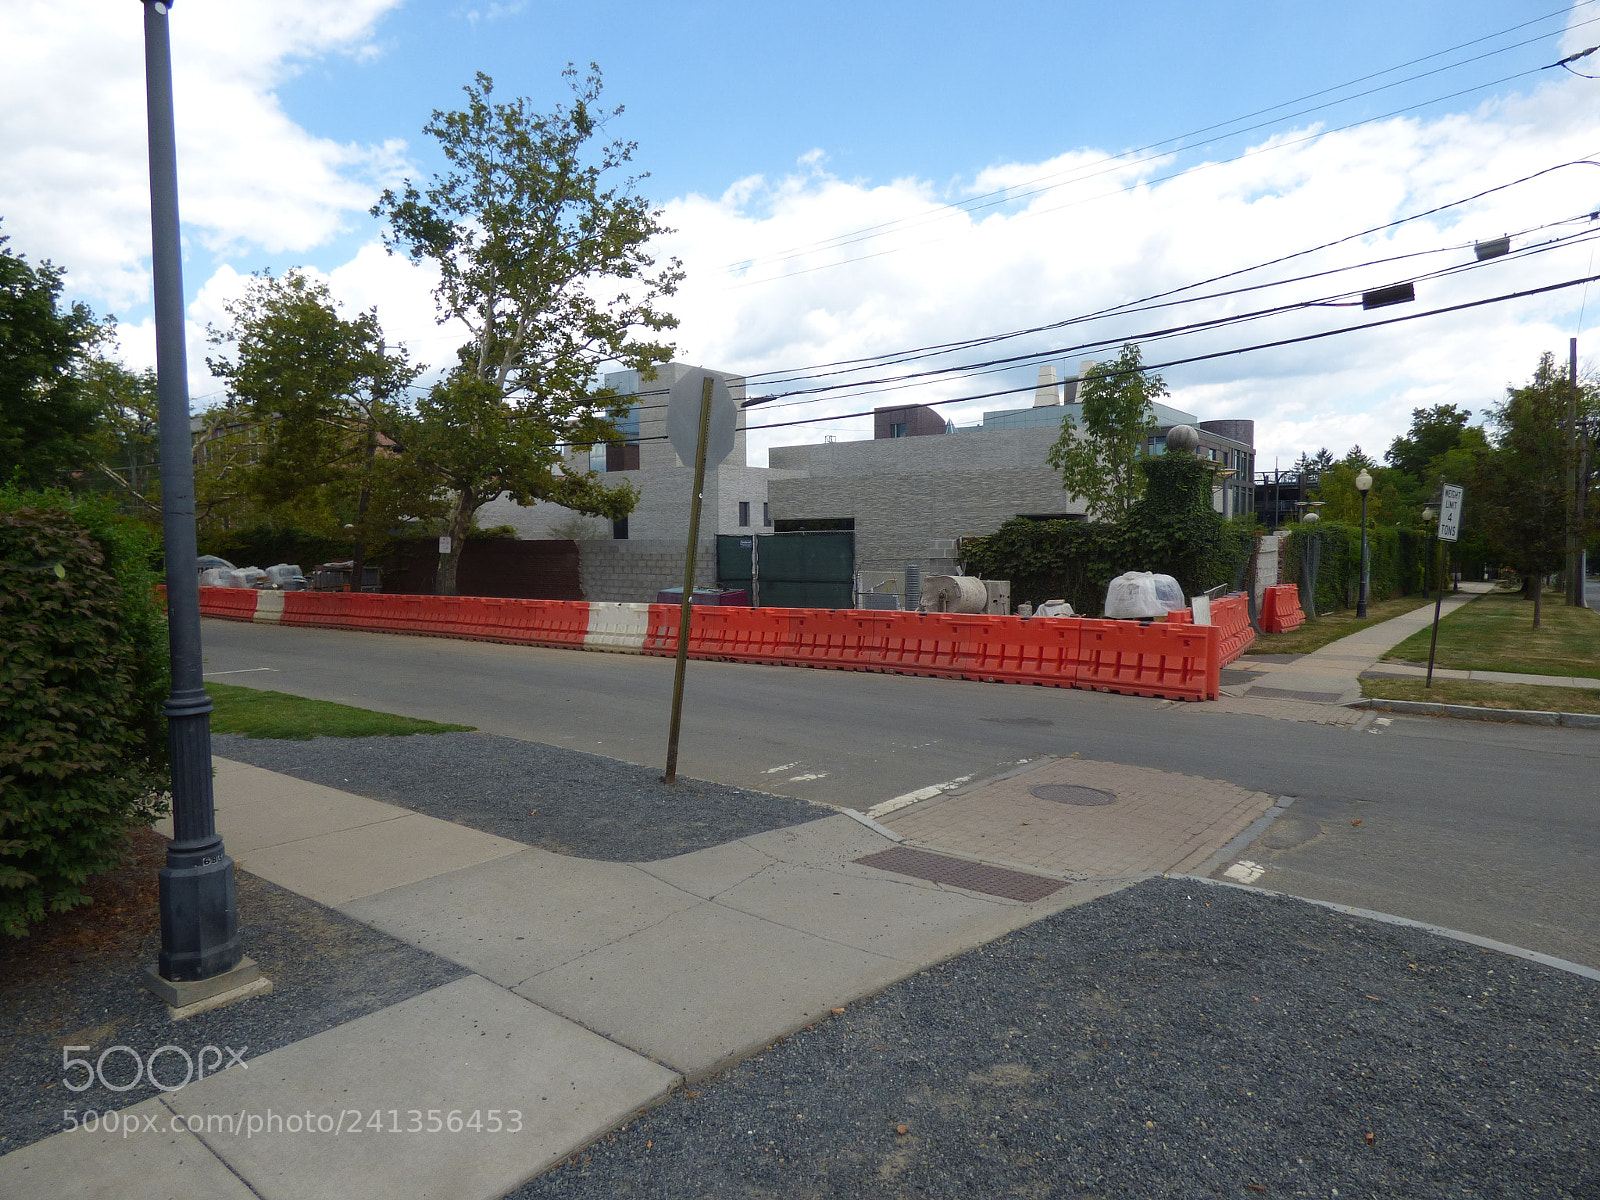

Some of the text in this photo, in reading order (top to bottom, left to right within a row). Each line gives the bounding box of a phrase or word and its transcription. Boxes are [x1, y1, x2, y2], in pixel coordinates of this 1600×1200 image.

[1445, 489, 1461, 499] WEIGHT
[1445, 501, 1457, 509] LIMIT
[1447, 512, 1453, 522] 4
[1441, 524, 1456, 537] TONS
